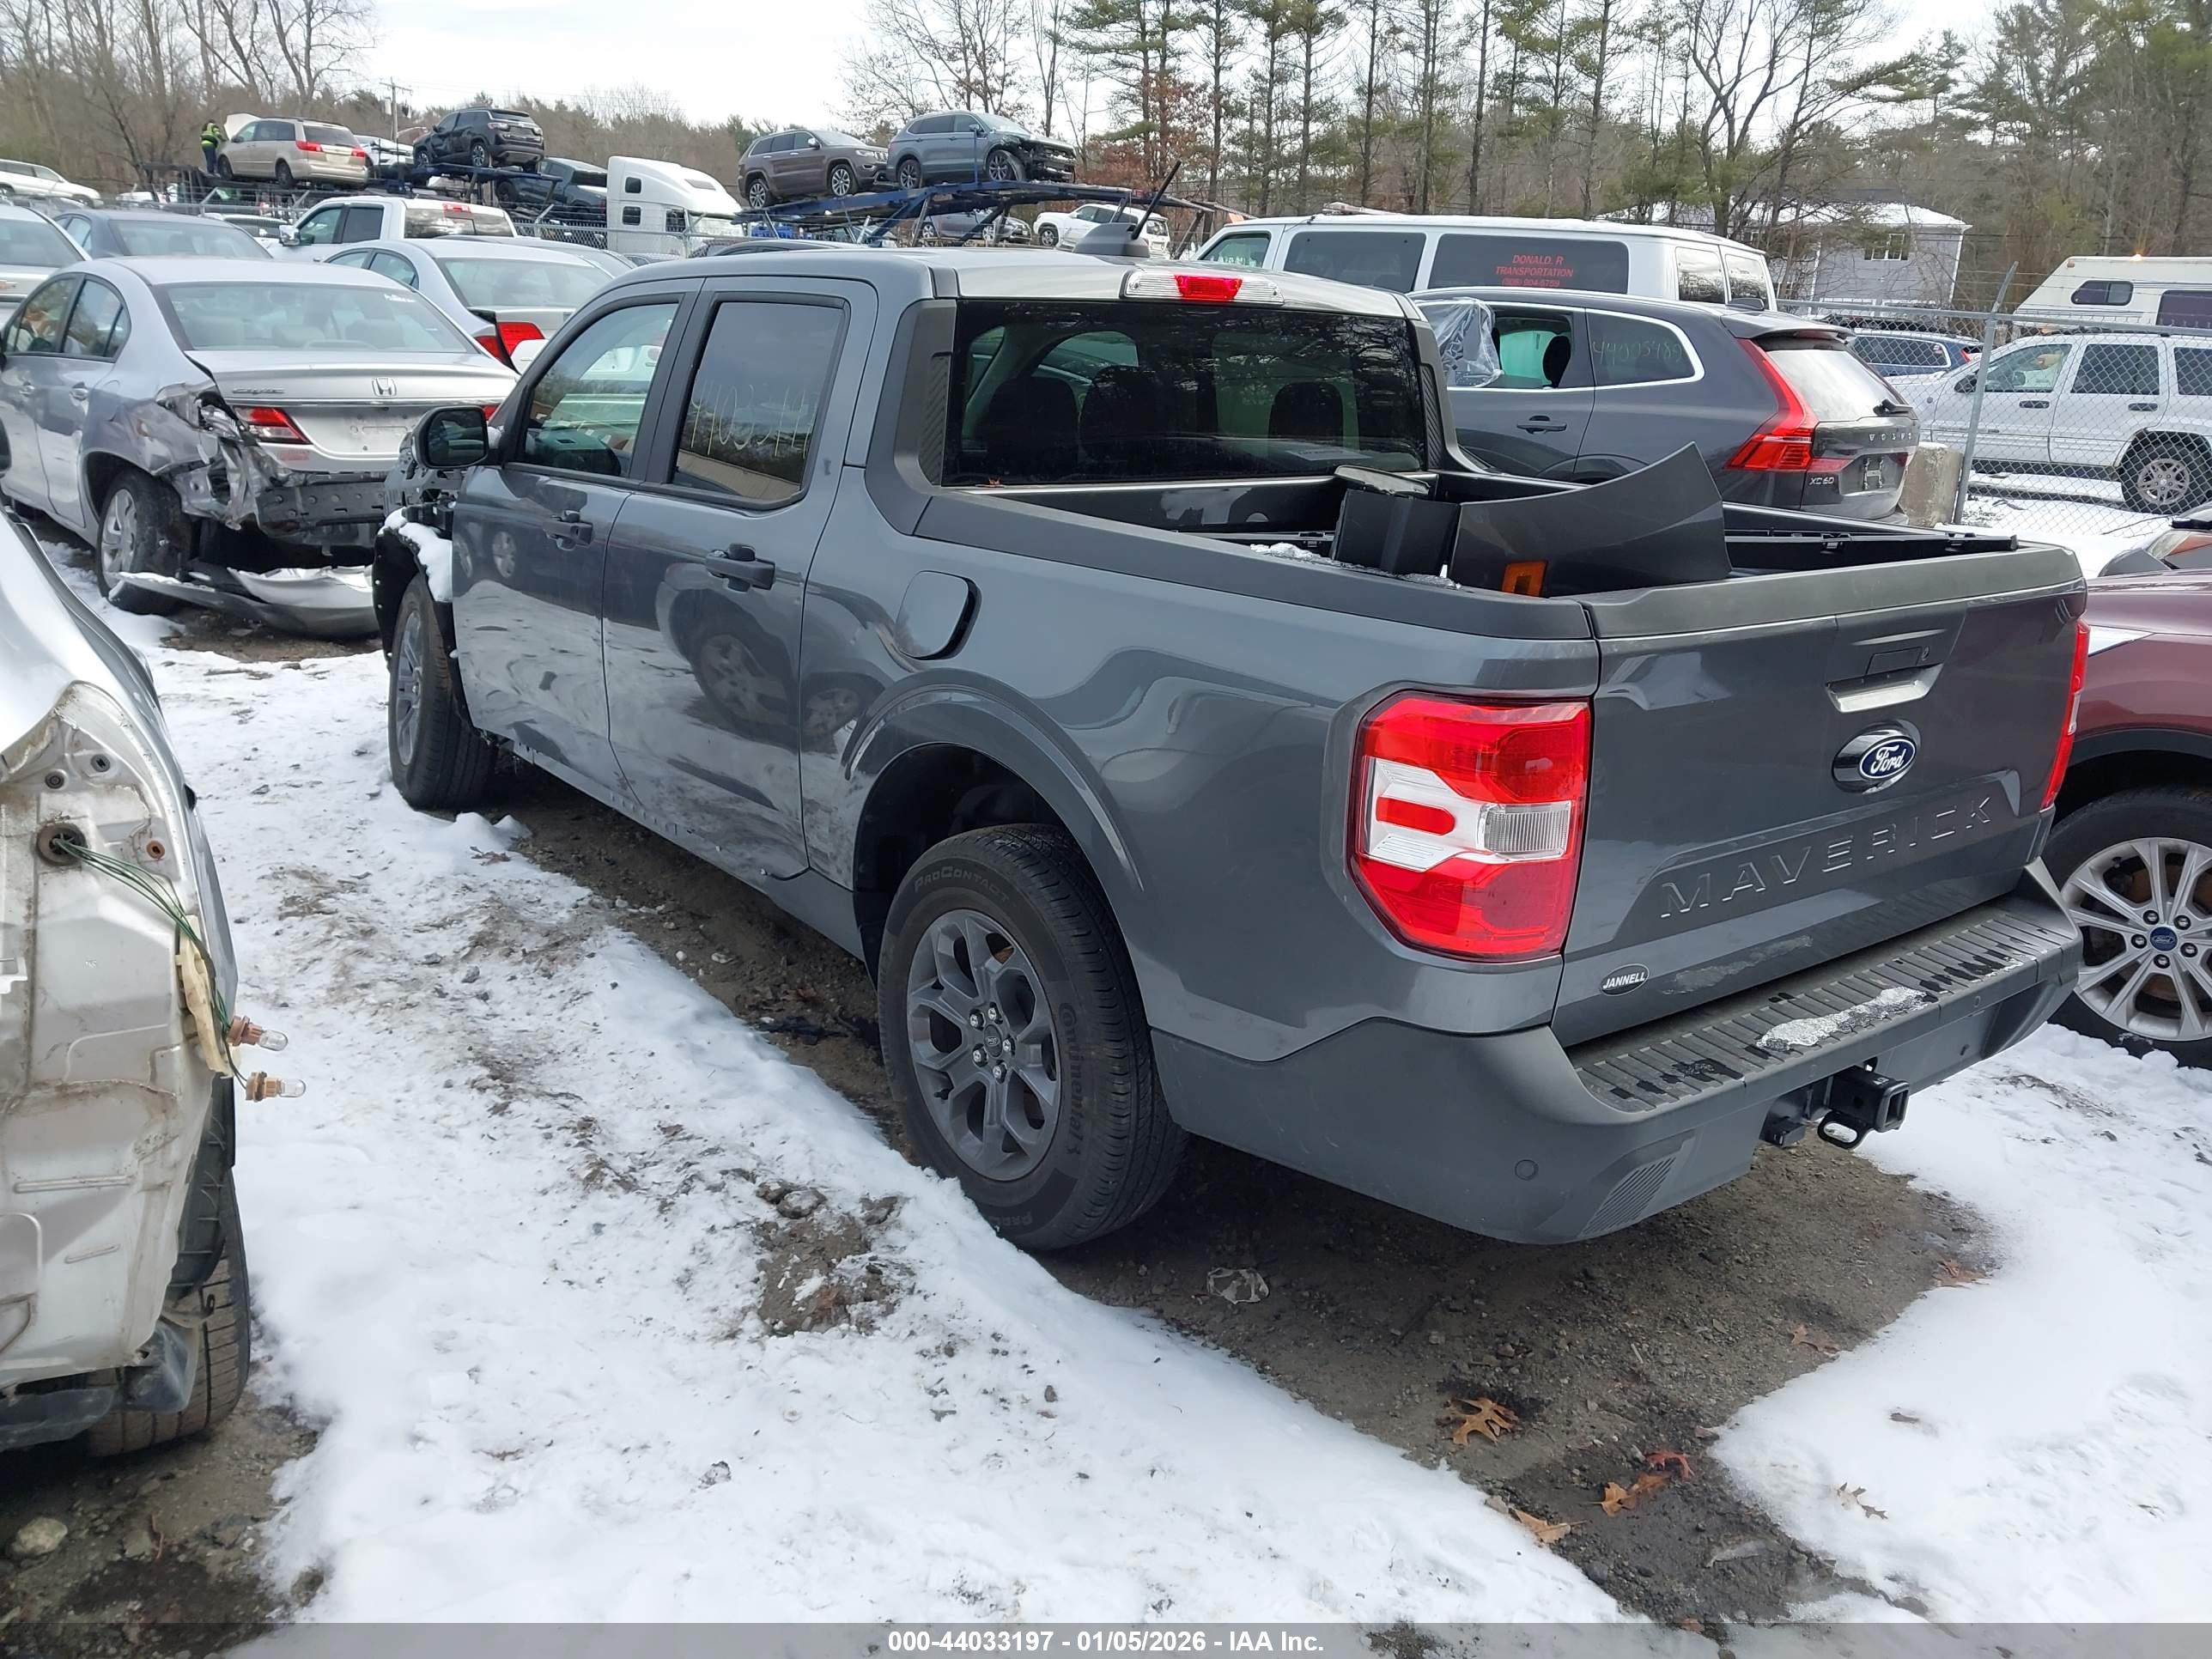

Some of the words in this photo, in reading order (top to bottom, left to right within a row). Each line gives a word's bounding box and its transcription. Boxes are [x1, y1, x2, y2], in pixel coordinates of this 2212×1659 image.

[1555, 256, 1564, 265] R
[1496, 266, 1574, 277] TRANSPORTATION
[1869, 433, 1912, 441] VOLVO
[1808, 477, 1835, 485] XC60
[1870, 744, 1907, 775] Ford
[1661, 797, 1991, 918] MAVERICK
[1602, 971, 1646, 989] JANNELL
